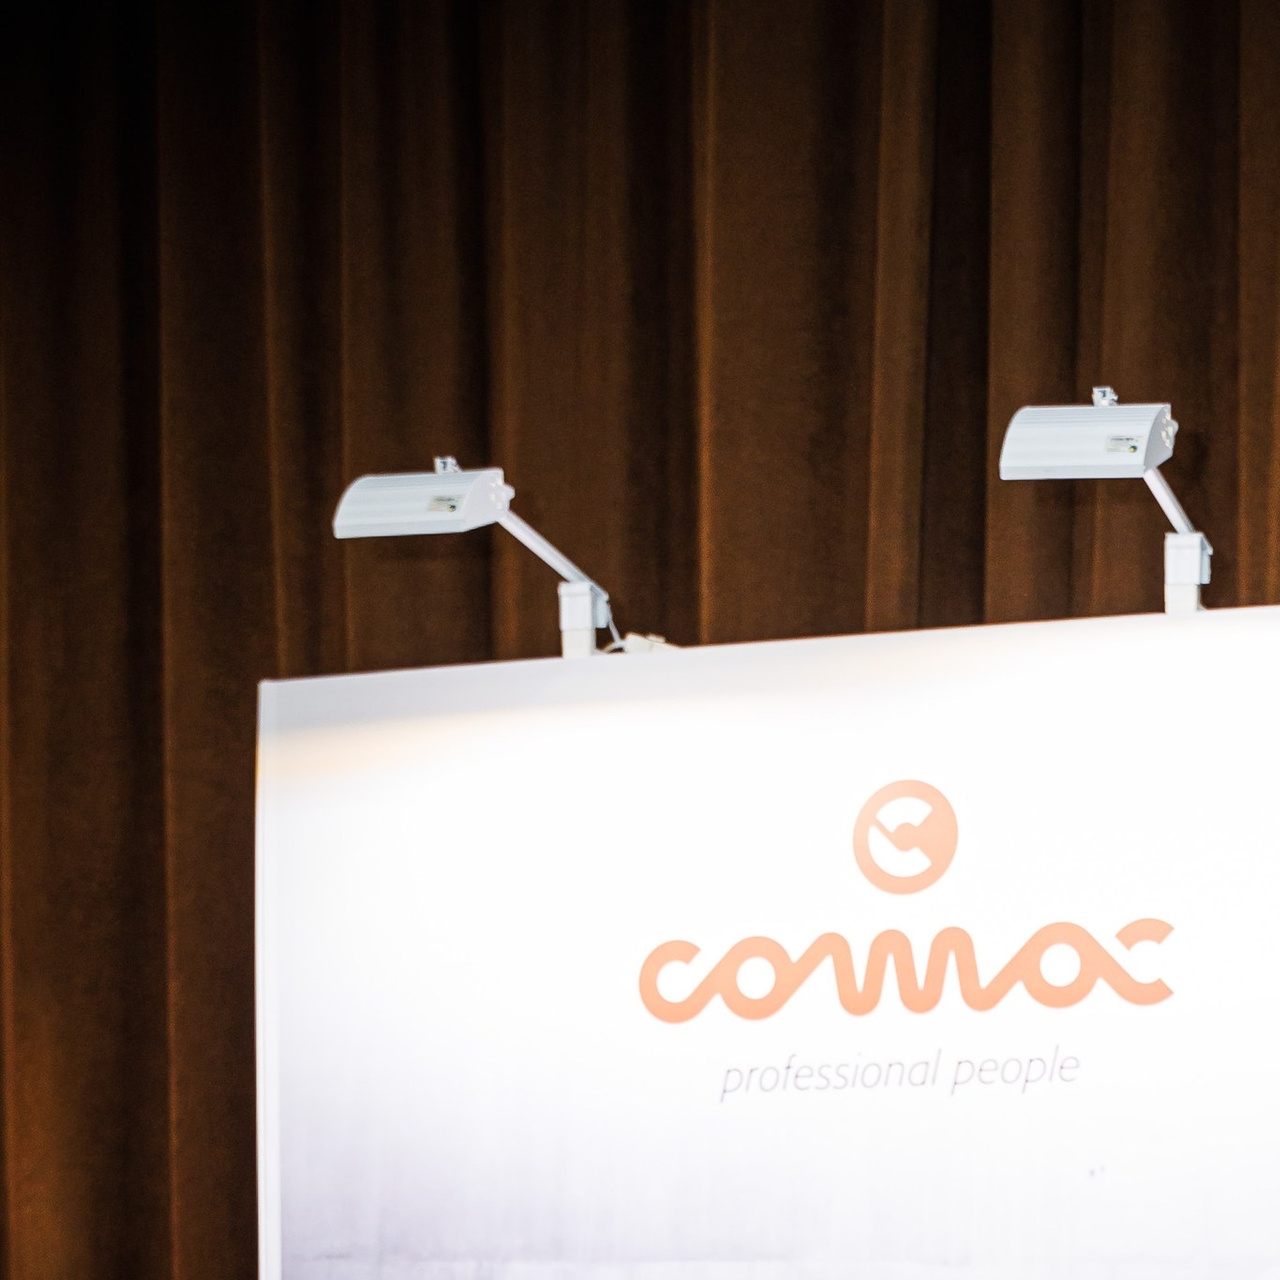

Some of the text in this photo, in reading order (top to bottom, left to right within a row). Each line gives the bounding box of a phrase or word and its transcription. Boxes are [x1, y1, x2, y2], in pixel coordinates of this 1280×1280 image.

[639, 918, 1175, 1024] comac
[720, 1045, 1081, 1103] professional people
